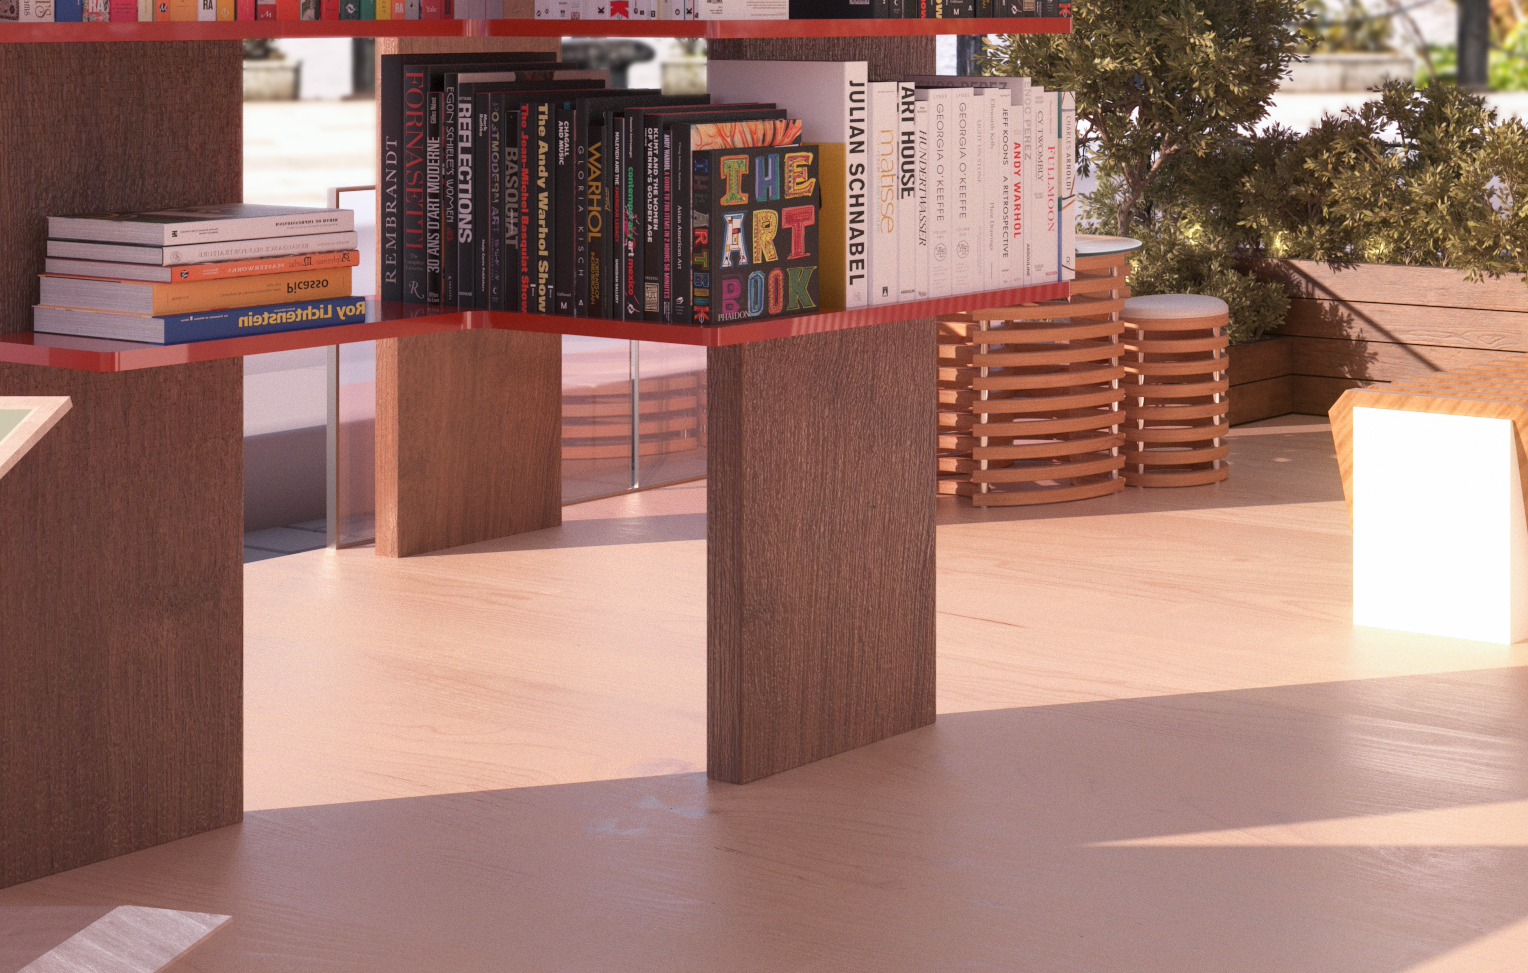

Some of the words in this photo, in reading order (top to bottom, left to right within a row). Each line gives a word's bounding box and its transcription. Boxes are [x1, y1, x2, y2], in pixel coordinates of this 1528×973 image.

[445, 86, 454, 123] EGON
[849, 80, 866, 154] JULIAN
[900, 86, 915, 125] ART
[936, 103, 945, 161] GEORGIA
[959, 102, 967, 159] GEORGIA
[405, 69, 424, 251] FORNASETTI
[647, 127, 653, 140] OF
[1013, 141, 1021, 179] ANDY
[427, 136, 440, 194] MODERNE
[458, 103, 473, 243] REFLECTIONS
[720, 151, 817, 206] THE
[880, 130, 897, 234] matisse
[900, 131, 915, 200] HOUSE
[918, 130, 928, 246] HUNDERTWASSER
[385, 136, 398, 285] REMBRANDT
[445, 178, 454, 223] WOMEN
[849, 163, 866, 285] SCHNABEL
[1013, 182, 1021, 238] WARHOL
[427, 233, 440, 256] ANS
[720, 204, 815, 269] ART
[427, 258, 440, 273] 30
[722, 266, 818, 317] BOOK
[717, 310, 752, 322] PHAIDON
